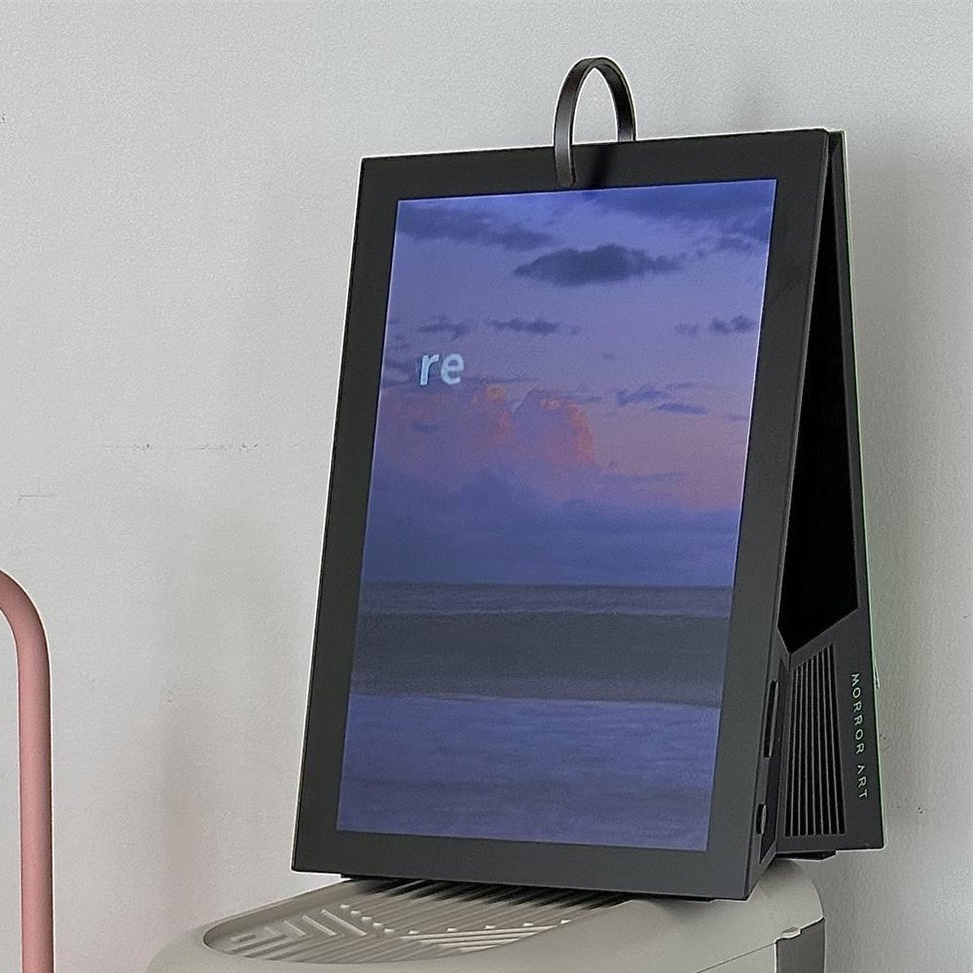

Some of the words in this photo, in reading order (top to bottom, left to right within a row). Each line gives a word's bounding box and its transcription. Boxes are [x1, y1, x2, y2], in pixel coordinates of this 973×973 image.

[419, 353, 465, 386] re
[850, 672, 866, 755] MORROR
[856, 763, 869, 799] ART
